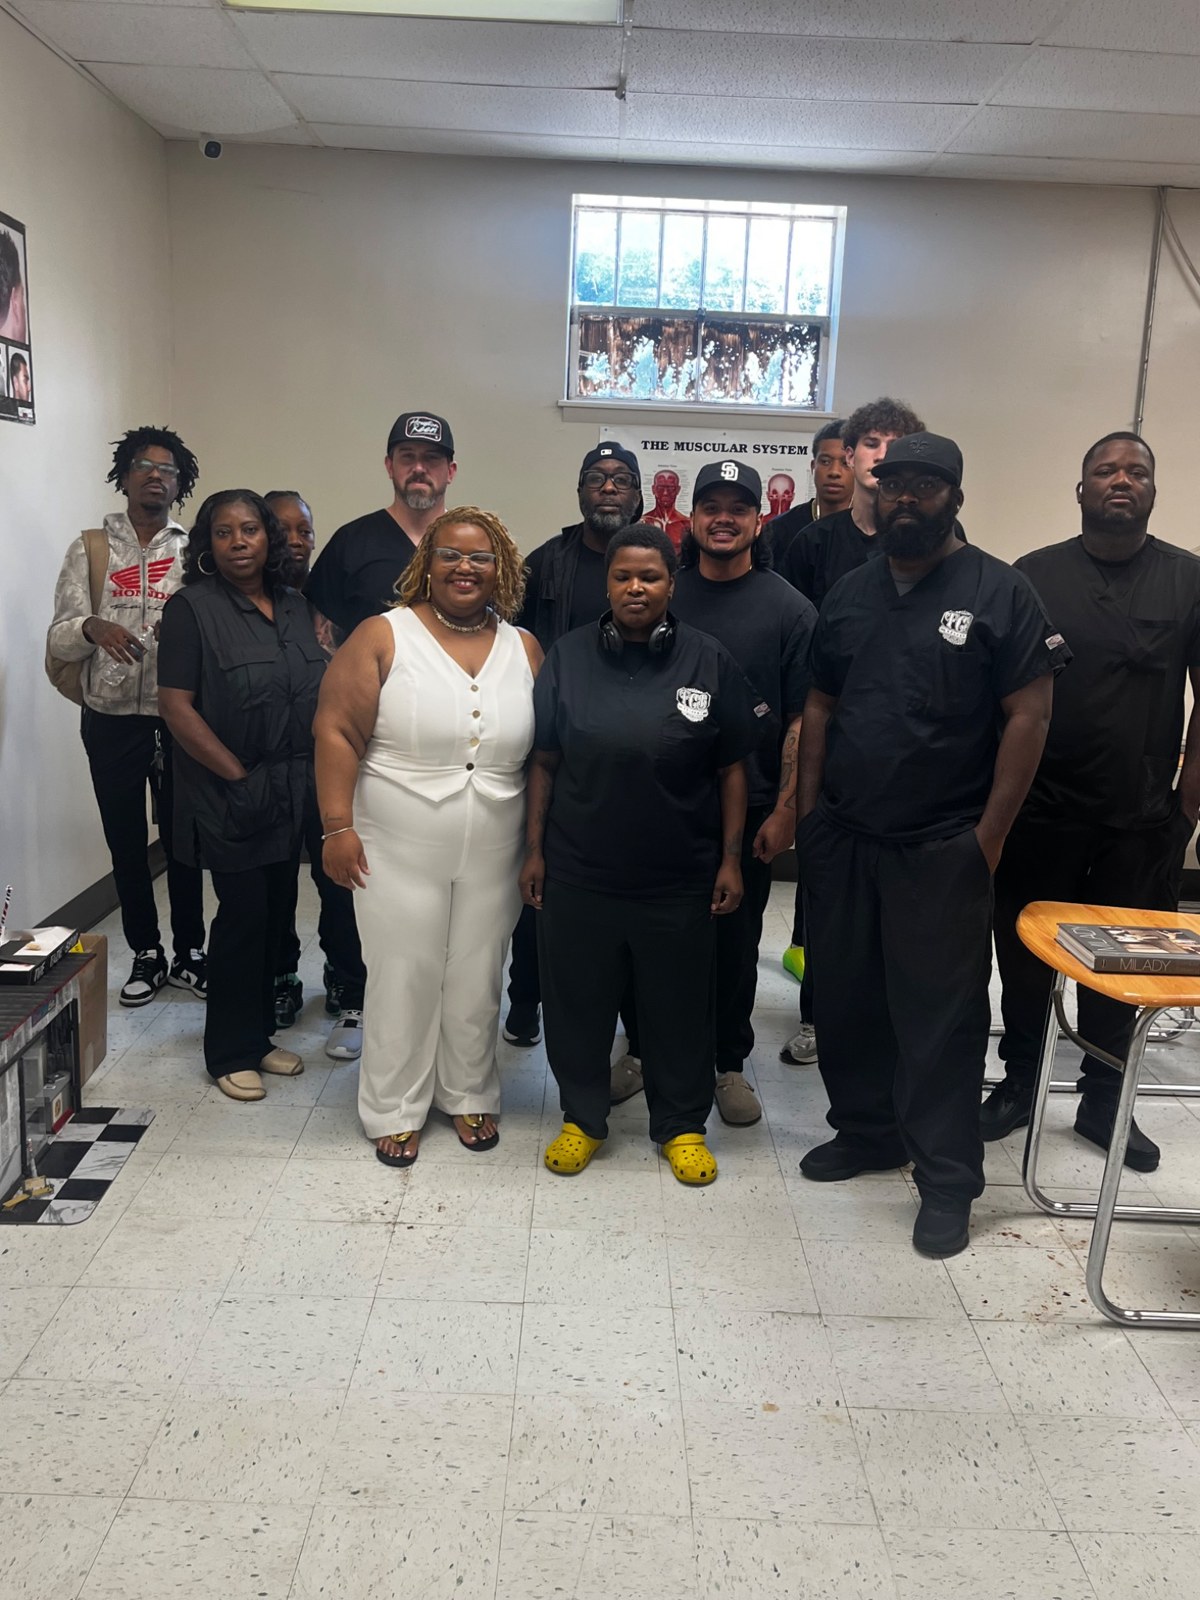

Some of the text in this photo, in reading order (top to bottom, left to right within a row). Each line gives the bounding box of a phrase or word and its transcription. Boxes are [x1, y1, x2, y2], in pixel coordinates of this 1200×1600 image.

[641, 440, 808, 455] THE MUSCULAR SYSTEM
[721, 462, 739, 481] SD
[1120, 958, 1171, 972] MILADY
